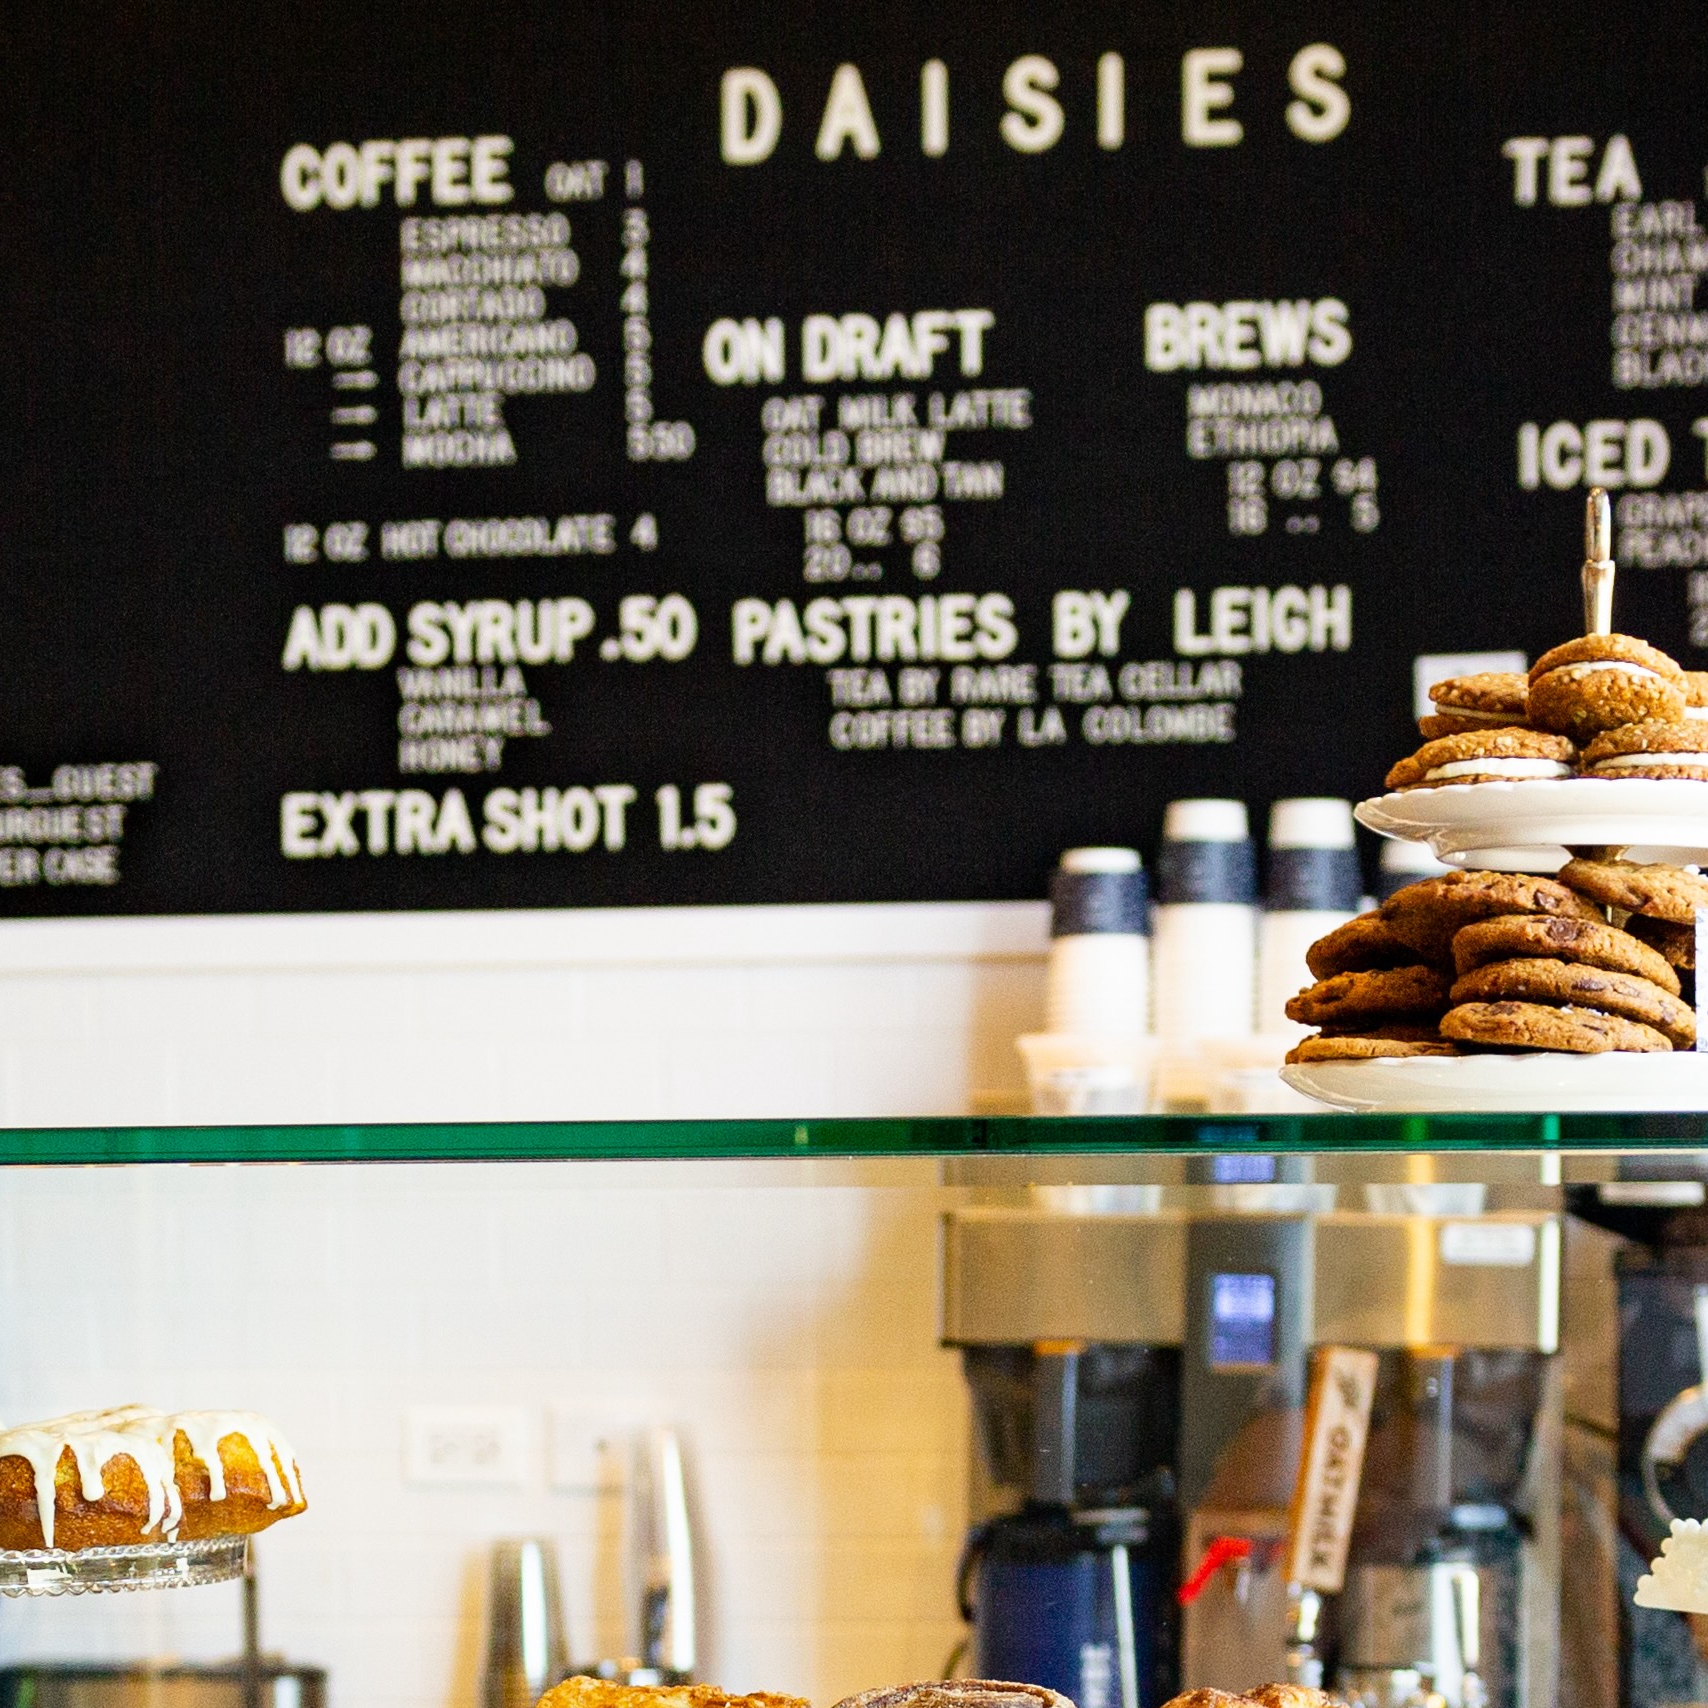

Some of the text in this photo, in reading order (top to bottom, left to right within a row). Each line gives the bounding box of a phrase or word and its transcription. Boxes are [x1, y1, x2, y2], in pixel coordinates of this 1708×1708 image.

[719, 42, 1352, 167] DAISIES
[279, 134, 514, 211] COFFEE
[1502, 134, 1643, 207] TEA
[399, 212, 572, 252] ESPRESSO
[1611, 200, 1704, 241] EARL
[1612, 274, 1698, 312] MINT
[283, 318, 578, 368] 12 OZ AMERICANO
[702, 309, 995, 385] ON DRAFT
[1144, 296, 1352, 372] BREWS
[402, 392, 505, 429] LATTE
[760, 388, 1032, 434] OAT MILK LATTE
[1187, 380, 1322, 419] MONACO
[400, 429, 516, 469] MOCHA
[761, 426, 945, 469] COLD BREW
[1186, 416, 1339, 459] ETHIOPIA
[1517, 420, 1670, 489] ICED
[764, 461, 1004, 506] BLACK AND TAN
[1227, 460, 1266, 499] 12
[1271, 458, 1321, 499] OZ
[282, 513, 659, 563] 12 OZ HOT CHOCOLATE 4
[844, 505, 892, 546] OZ
[281, 592, 698, 672] ADD SYRUP .50
[732, 585, 1353, 666] PASTRIES BY LEIGH
[396, 665, 527, 699] VANILLA
[827, 661, 1244, 707] TEA BY RARE TEA CELLAR
[397, 698, 552, 738] CARAMEL
[830, 704, 1236, 749] COFFEE BY LA COLOMBE
[398, 737, 505, 773] HONEY
[279, 782, 737, 859] EXTRA SHOT 1.5
[43, 845, 122, 886] CASE
